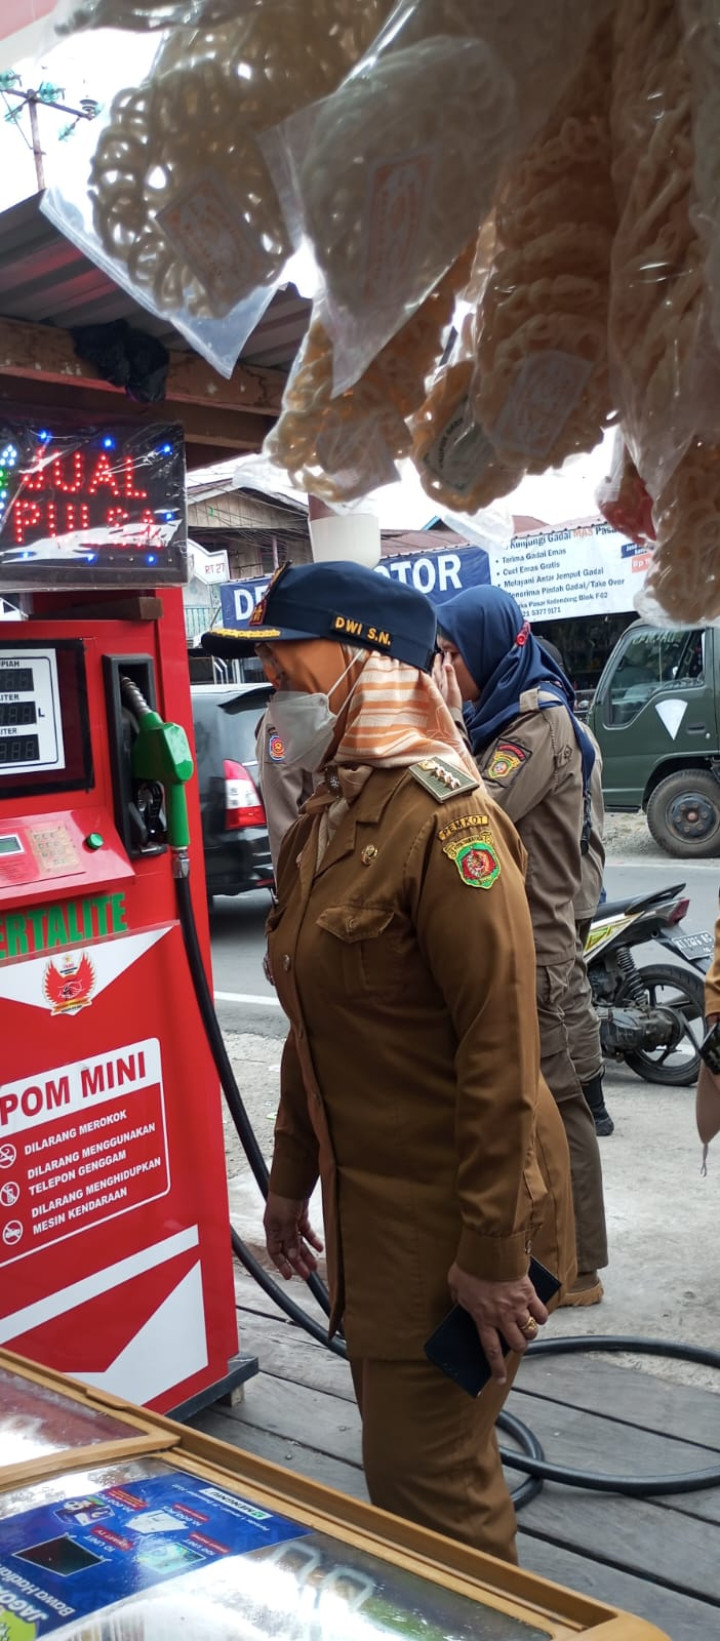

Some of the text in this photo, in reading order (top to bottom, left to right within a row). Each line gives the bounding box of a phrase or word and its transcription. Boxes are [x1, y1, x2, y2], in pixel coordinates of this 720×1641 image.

[22, 446, 148, 498] JUAL
[510, 534, 546, 549] Kunjungi
[547, 530, 571, 542] Gadai
[502, 548, 567, 564] Terima Gadai Emas
[520, 565, 538, 573] Emas
[540, 561, 560, 570] Gratis
[204, 565, 214, 574] RT
[373, 554, 463, 595] TOR
[504, 577, 535, 587] Melayani
[556, 570, 581, 580] Jemput
[583, 567, 604, 576] Gadai
[508, 588, 540, 598] enerima
[541, 585, 564, 595] Pindah
[608, 578, 625, 586] Over
[335, 616, 391, 645] DWI S.N.
[0, 660, 20, 668] PIAH
[0, 693, 20, 701] ITER
[38, 707, 45, 717] L
[0, 727, 17, 735] ITER
[0, 1051, 146, 1126] POM MINI
[24, 1109, 127, 1155] DILARANG MEROKOK
[27, 1122, 156, 1180] DILARANG MENGGUNAKAN
[28, 1149, 127, 1196] TELEPON GENGGAM
[31, 1156, 161, 1218] DILARANG MENGHIDUPKAN
[33, 1186, 128, 1235] MESIN KENDARAAN
[0, 1564, 76, 1617] Bawa Hadia
